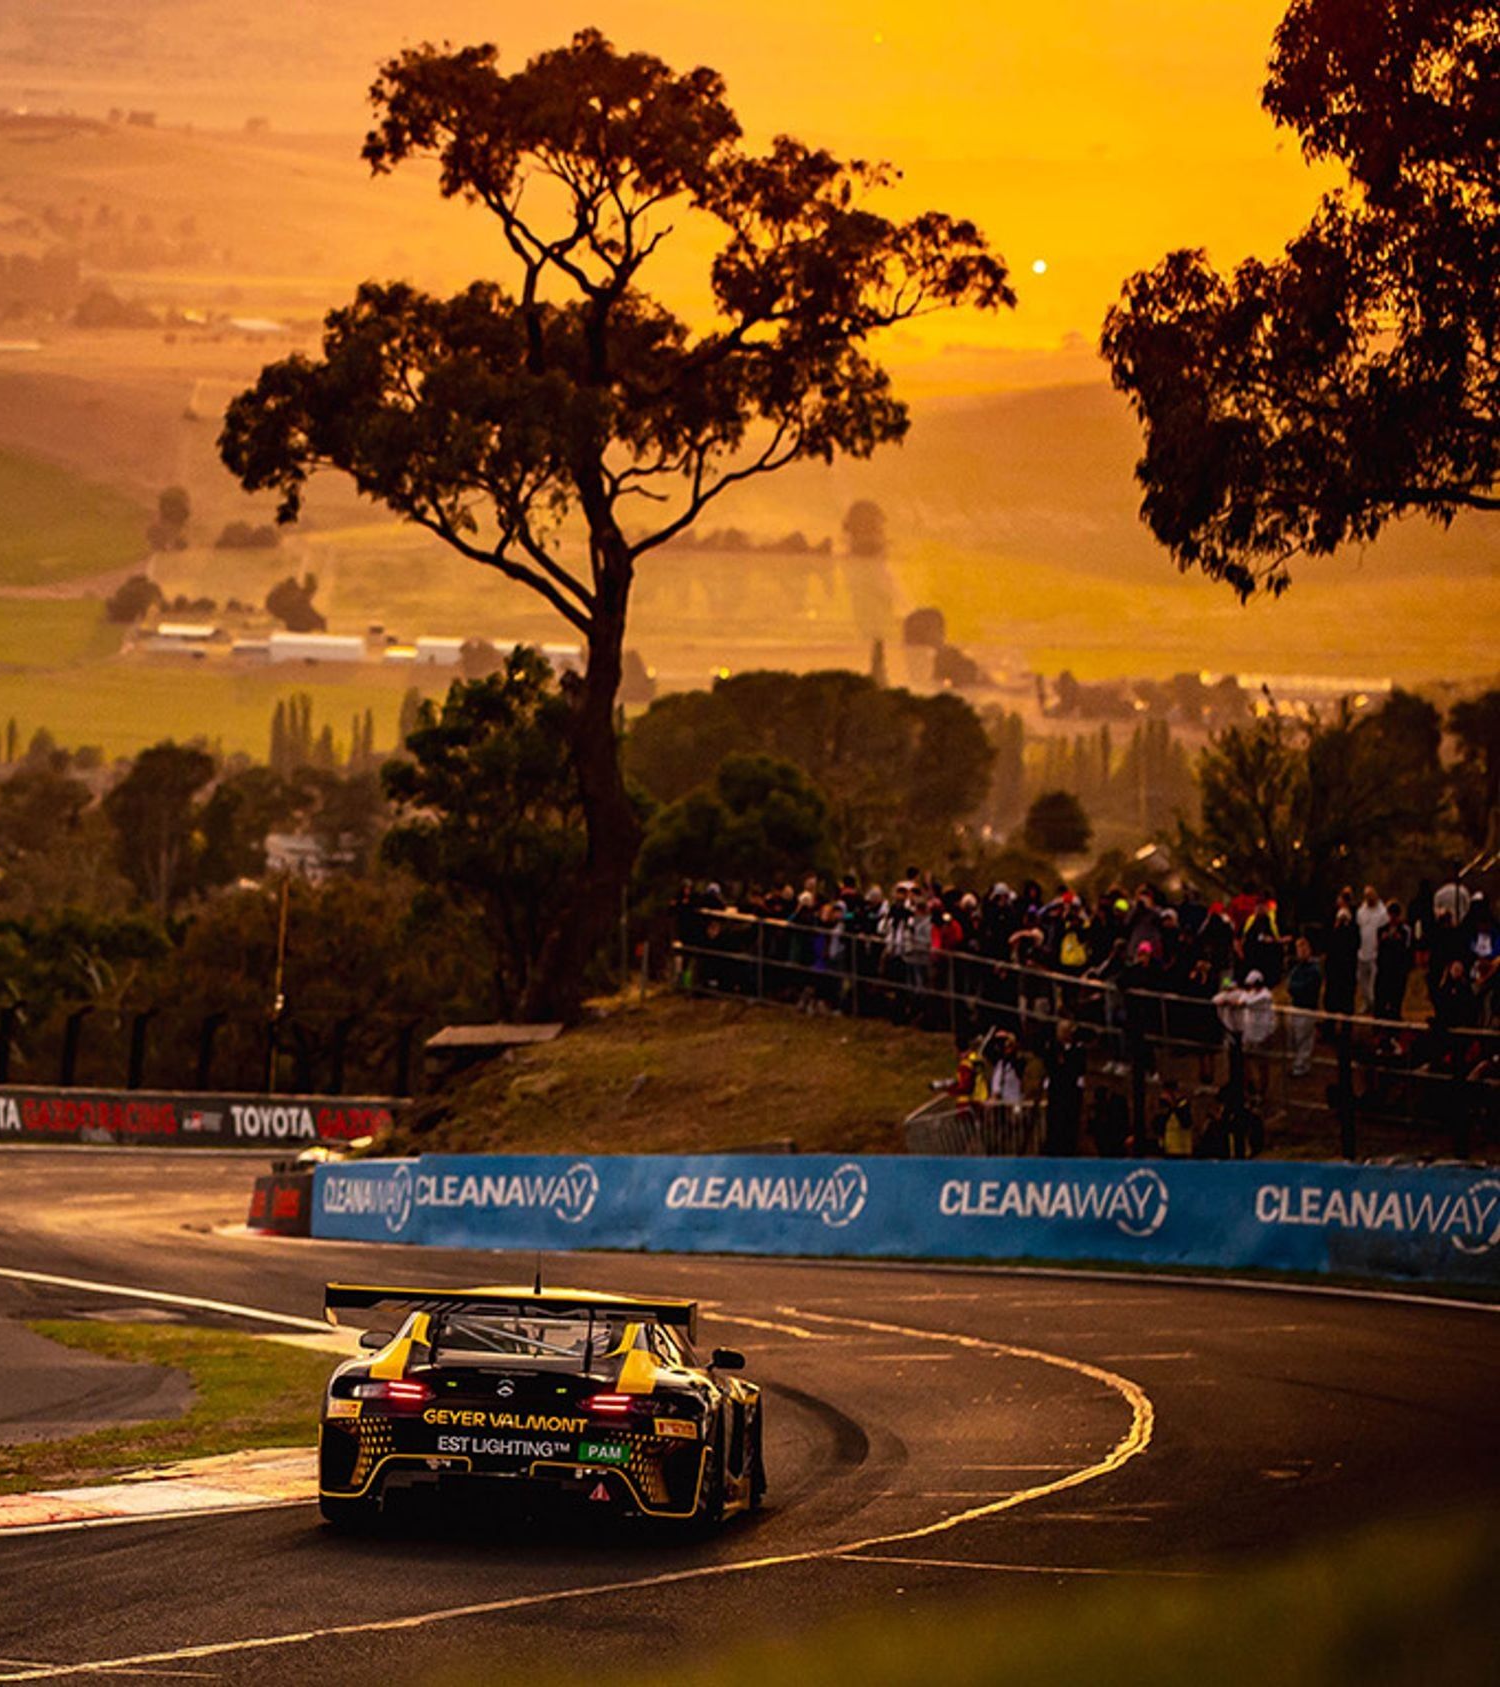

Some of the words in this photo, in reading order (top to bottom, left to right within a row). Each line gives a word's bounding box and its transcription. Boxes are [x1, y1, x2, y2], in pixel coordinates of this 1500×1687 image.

[22, 1098, 96, 1131] GAZOO
[231, 1106, 315, 1138] TOYOTA
[415, 1174, 592, 1210] CLEANAWAY
[665, 1175, 858, 1213] CLEANAWAY
[940, 1179, 1155, 1221] CLEANAWAY
[1256, 1185, 1498, 1235] CLEANAWAY
[423, 1408, 486, 1427] GEYER
[489, 1412, 589, 1434] VALMONT
[437, 1435, 470, 1451] EST
[588, 1445, 622, 1460] PAM
